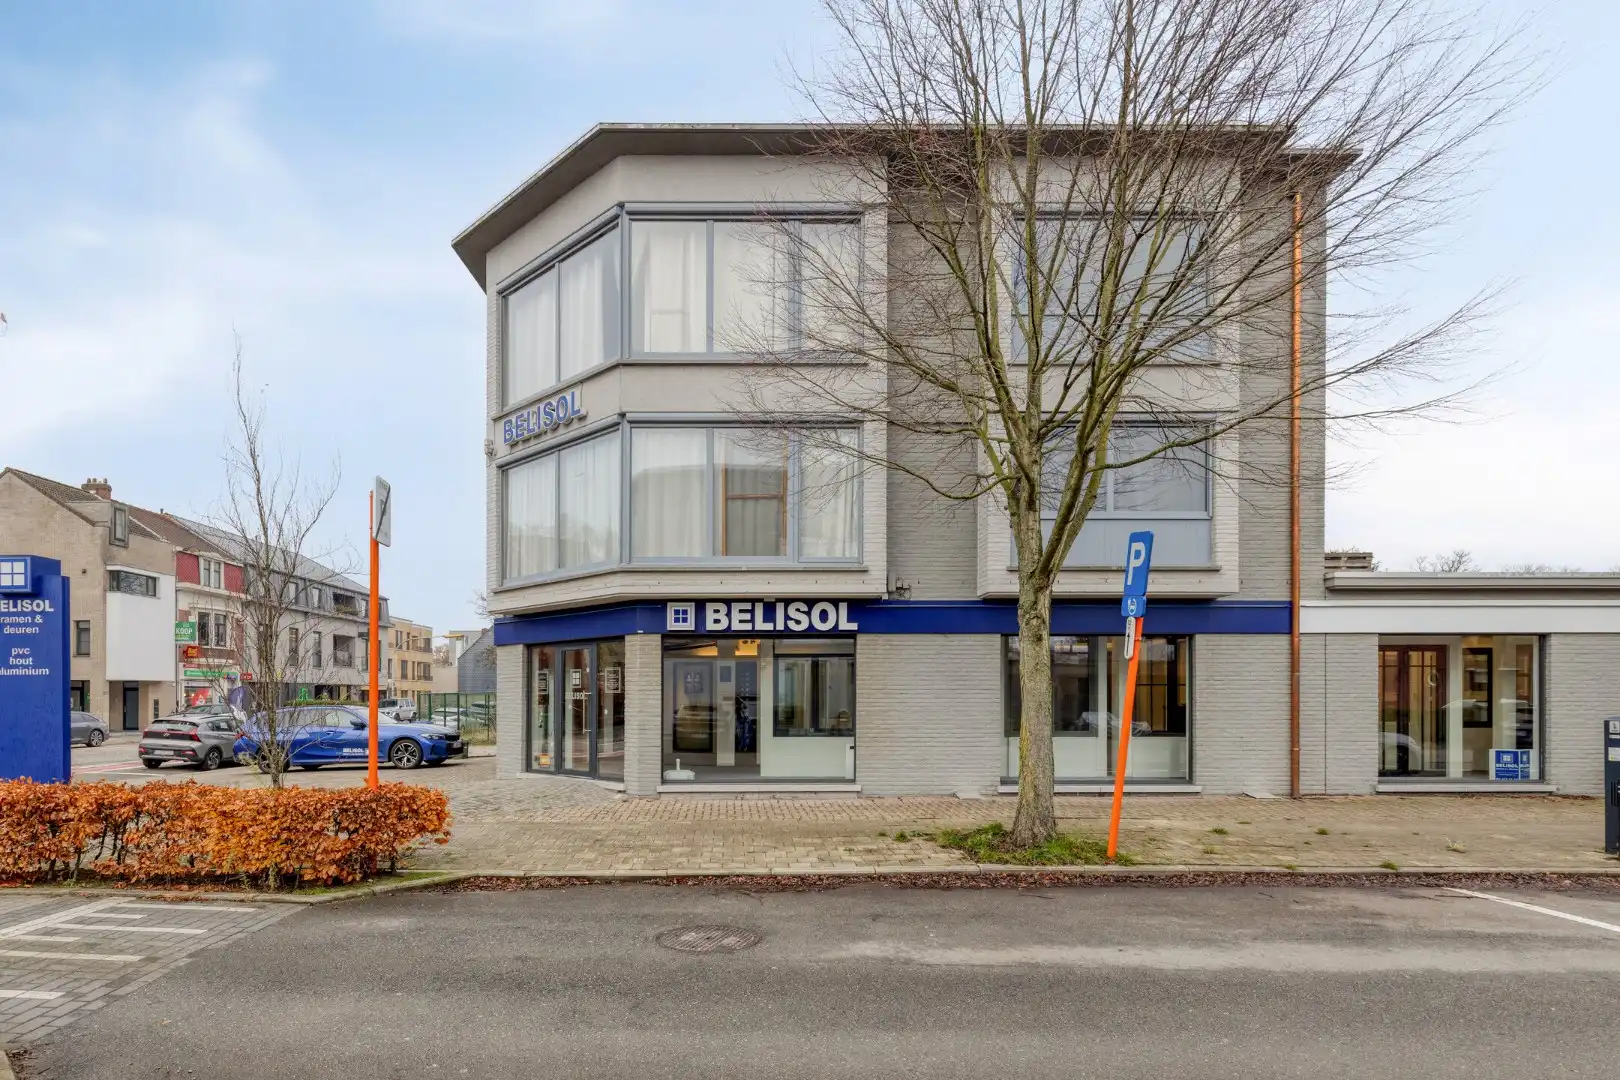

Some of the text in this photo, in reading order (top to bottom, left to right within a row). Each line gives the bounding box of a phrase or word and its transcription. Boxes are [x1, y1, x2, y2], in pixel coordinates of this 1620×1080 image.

[503, 391, 583, 444] BELISOL
[1127, 543, 1145, 585] P
[0, 599, 54, 613] ELISOL
[1, 614, 44, 624] ramen &
[705, 601, 858, 632] BELISOL
[4, 625, 39, 634] deuren
[175, 627, 193, 635] KOOP
[12, 647, 31, 657] pvc
[9, 656, 33, 665] hout
